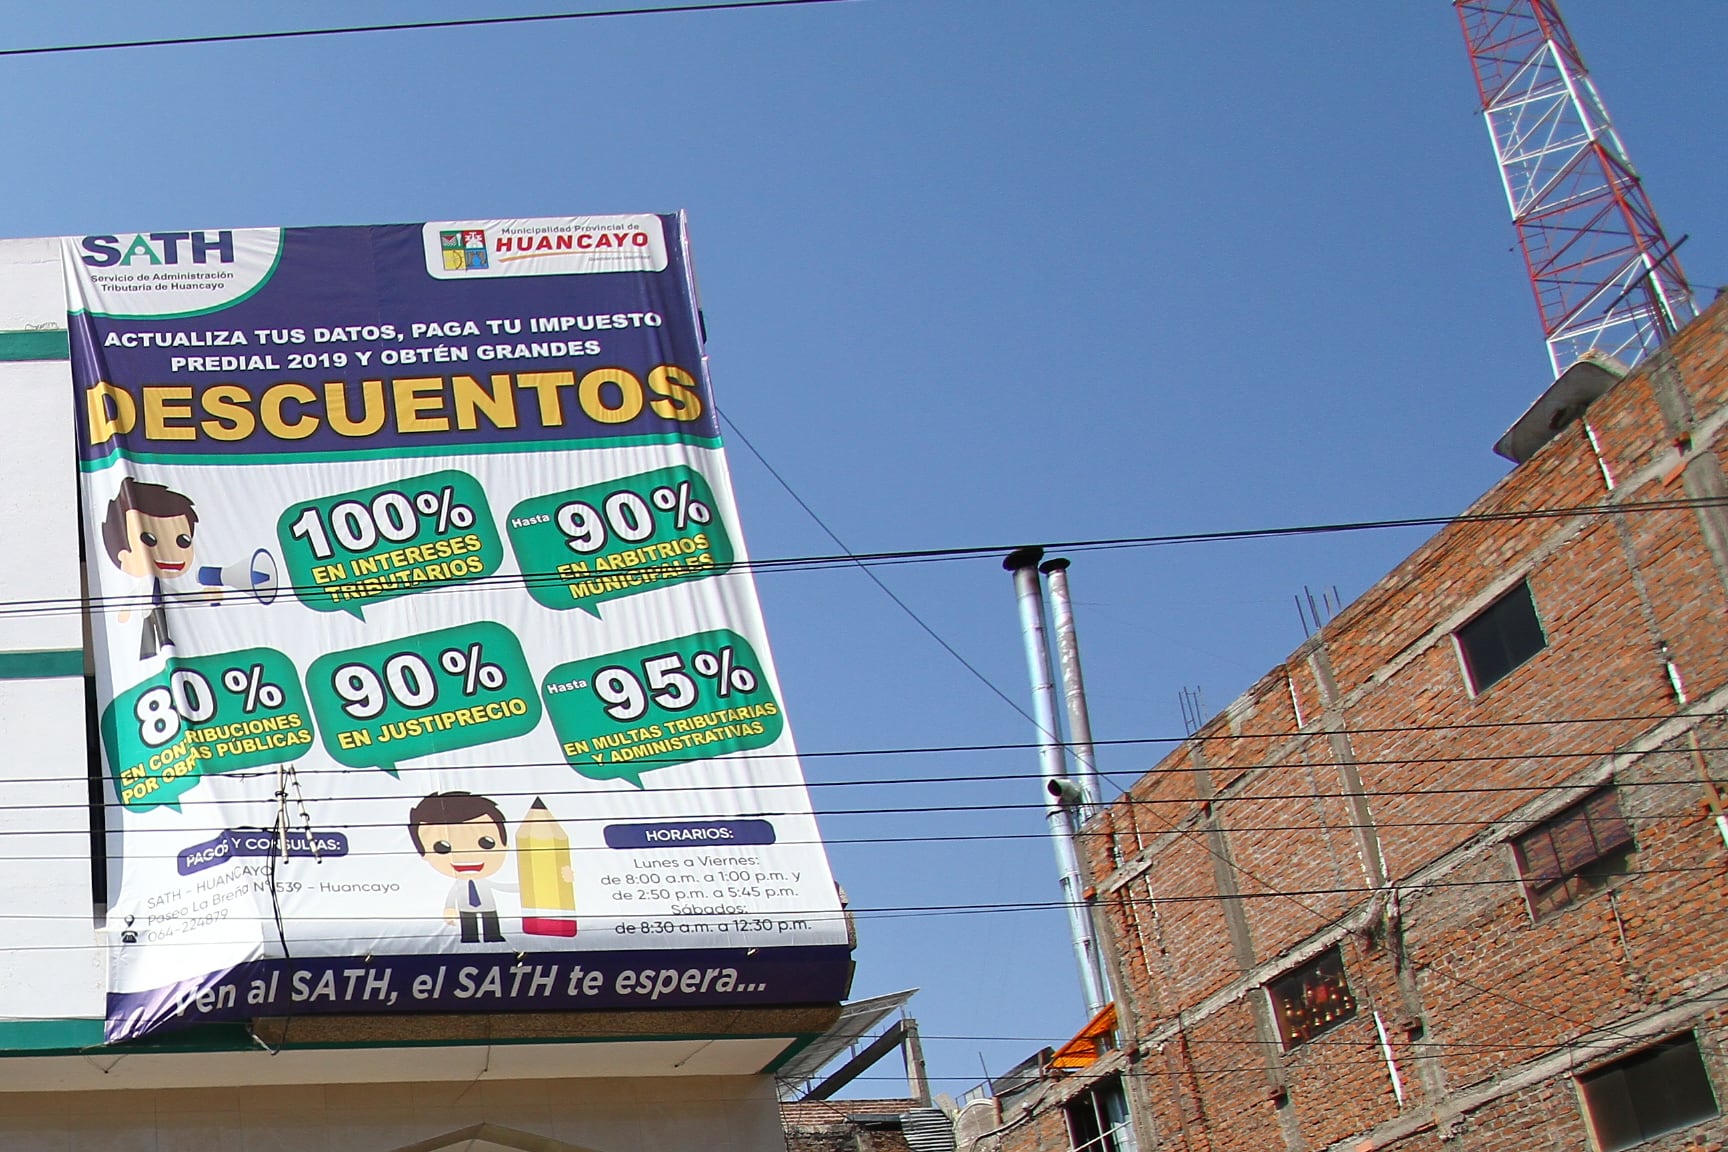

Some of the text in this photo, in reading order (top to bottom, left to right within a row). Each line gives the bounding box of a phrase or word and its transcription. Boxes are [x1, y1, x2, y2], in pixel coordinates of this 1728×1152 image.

[496, 232, 648, 252] HUANCAYO
[502, 223, 639, 235] Municipalidad Provincial de
[82, 231, 234, 267] SATH
[91, 272, 234, 283] Servicio de Administración
[101, 282, 225, 292] Tributaria de Huancayo
[104, 312, 662, 349] ACTUALIZA TUS DATOS, PAGA TU IMPUESTO
[171, 340, 601, 372] PREDIAL 2019 Y OBTÉN GRANDES
[86, 364, 703, 446] DESCUENTOS
[290, 486, 476, 561] 100%
[511, 513, 550, 529] Hasta
[554, 479, 712, 555] 90%
[312, 534, 482, 584] EN INTERESES
[557, 533, 710, 581] EN ARBITRIOS
[324, 556, 485, 603] TRIBUTARIOS
[569, 553, 715, 599] MUNICIPALES
[546, 678, 588, 695] Hasta
[592, 645, 757, 722] 95%
[337, 697, 528, 752] EN JUSTIPRECIO
[563, 702, 778, 757] EN MULTAS TRIBUTARIAS
[120, 713, 303, 786] EN CONRIBUCIONES
[592, 721, 765, 767] Y ADMINISTRATIVAS
[122, 777, 159, 805] POR
[215, 729, 312, 757] PÚBLICAS
[186, 838, 341, 867] PAGOS Y CONSULAS:
[645, 827, 734, 842] HORARIOS:
[600, 870, 801, 886] de 8:00 a.m. a 1:00 p.m. y
[633, 855, 760, 869] Lunes a Viernes:
[147, 889, 182, 910] SATH
[196, 865, 273, 894] HUANCAYO
[148, 907, 189, 927] Paseo
[193, 900, 208, 913] La
[212, 884, 249, 906] Breña
[276, 882, 302, 892] 539
[319, 880, 400, 894] Huancayo
[612, 886, 799, 902] de 2:50 p.m. a 5:45 p.m.
[147, 908, 229, 942] 064-224879
[615, 919, 812, 935] de 8:30 a.m. a 12:30 p.m.
[671, 903, 749, 916] Sábados:
[247, 970, 280, 1004] al
[291, 968, 398, 1006] SATH,
[412, 966, 447, 999] el
[453, 964, 557, 999] SATH
[567, 966, 604, 996] te
[614, 964, 767, 1000] espera...
